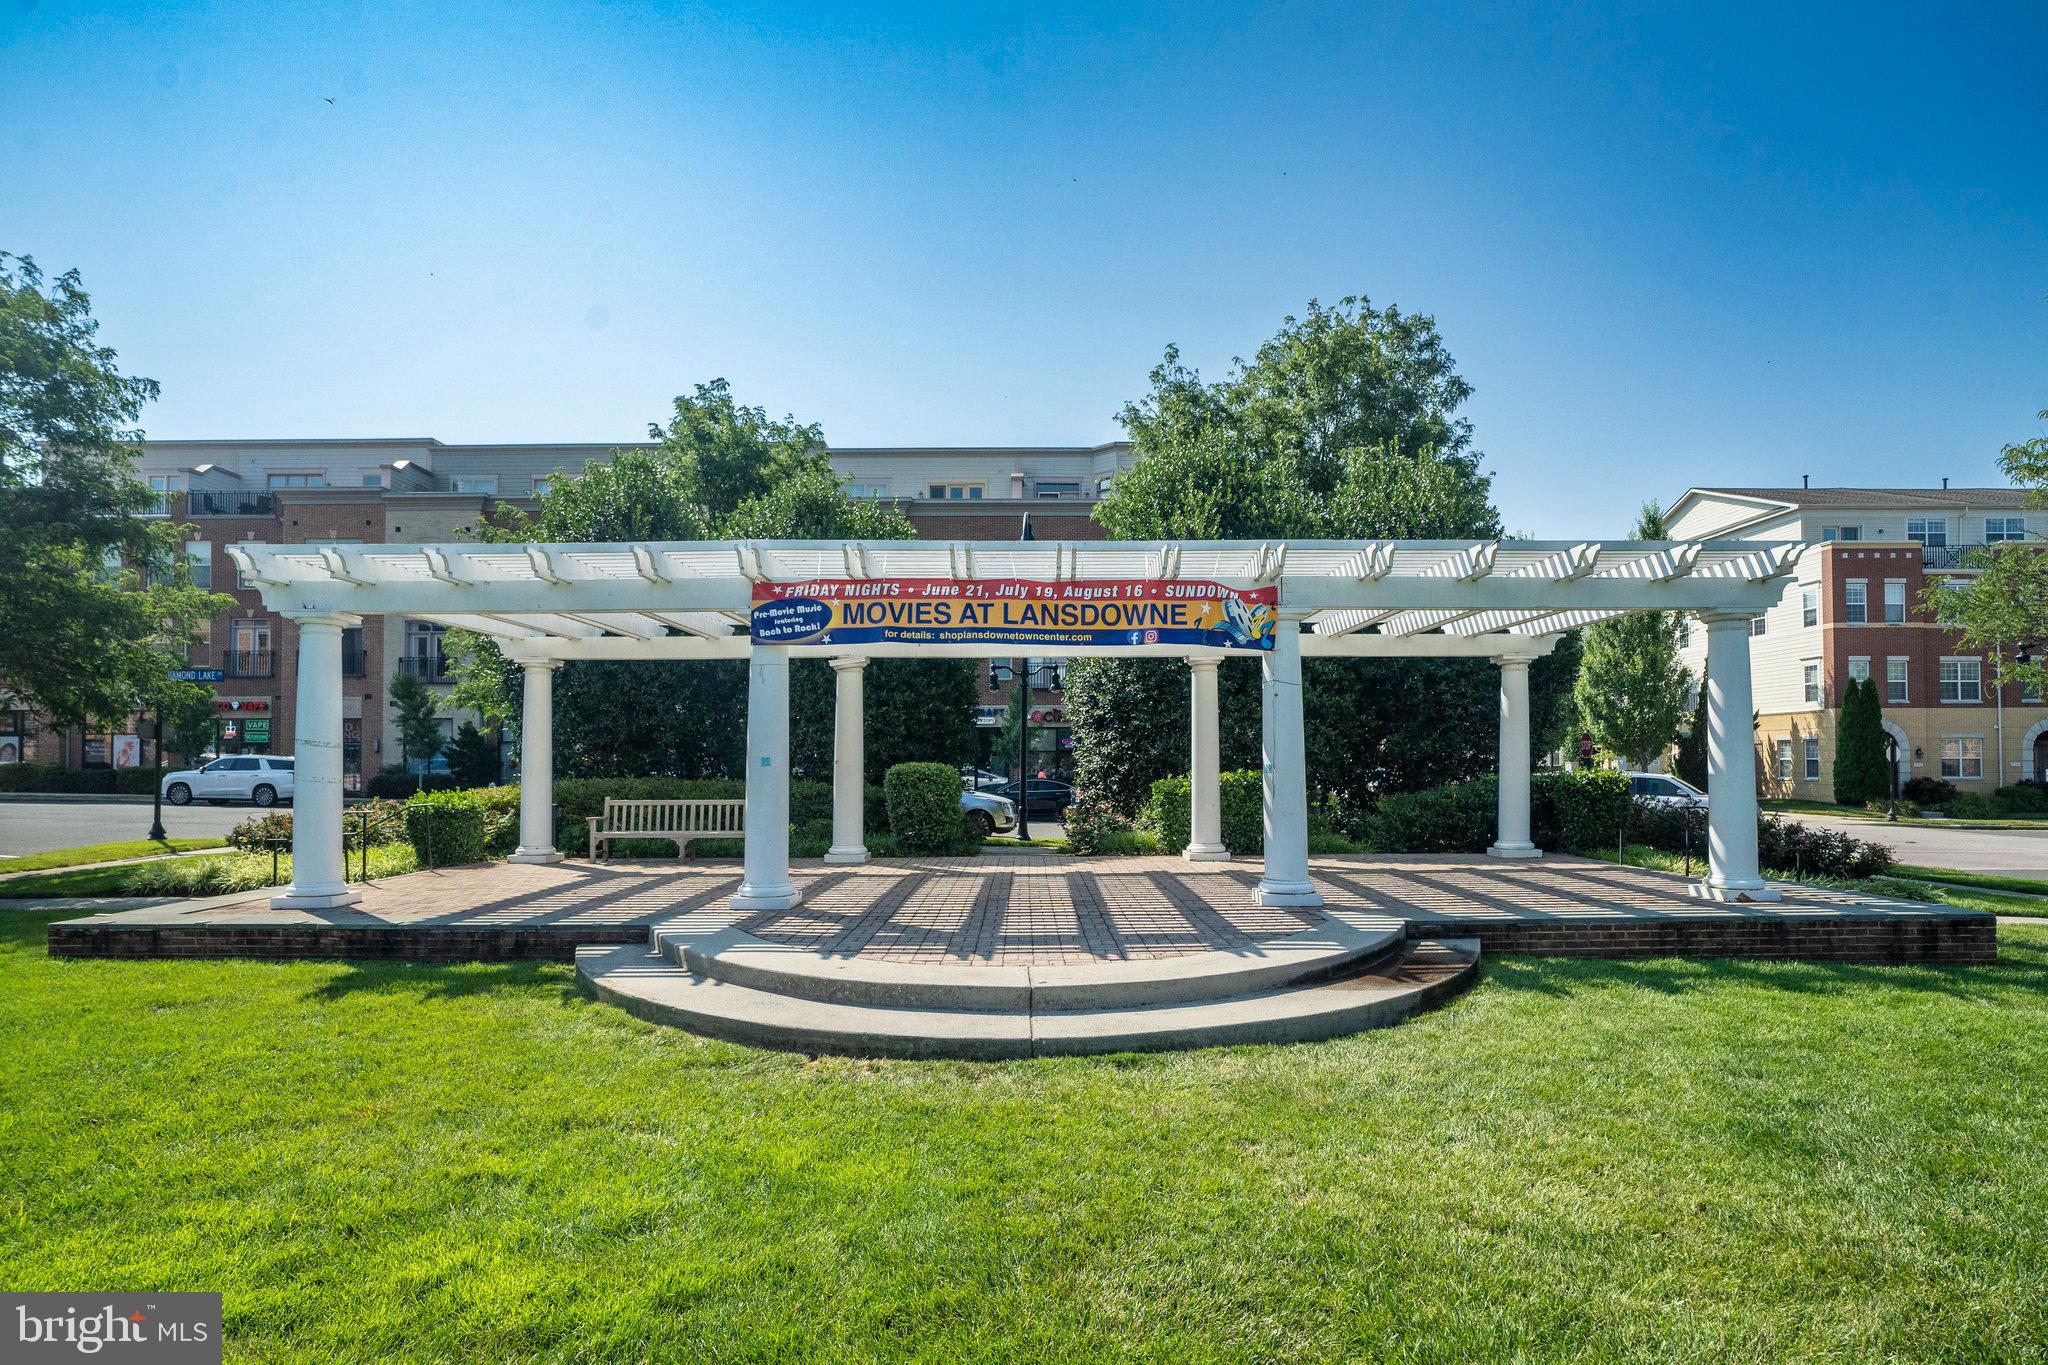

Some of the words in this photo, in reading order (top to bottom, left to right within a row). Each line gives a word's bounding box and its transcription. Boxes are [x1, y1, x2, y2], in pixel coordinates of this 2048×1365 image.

[785, 584, 840, 597] FRIDAY
[844, 583, 900, 597] NIGHTS
[922, 584, 960, 596] June
[965, 584, 989, 599] 21,
[995, 584, 1029, 599] July
[1035, 585, 1058, 599] 19,
[1063, 585, 1119, 600] August
[1125, 585, 1143, 597] 16
[1165, 585, 1239, 600] SUNDOWN
[753, 607, 795, 620] Pre-Movie
[796, 604, 823, 614] Music
[843, 602, 952, 625] MOVIES
[959, 602, 995, 625] AT
[1003, 602, 1188, 626] LANSDOWNE
[774, 617, 804, 625] featuring
[783, 626, 793, 634] to
[794, 622, 821, 633] Rock!
[884, 630, 898, 638] for
[900, 630, 935, 639] details:
[939, 630, 1092, 642] shoplansdownetowncenter.com
[198, 671, 216, 680] LAKE
[241, 701, 266, 712] VAPE
